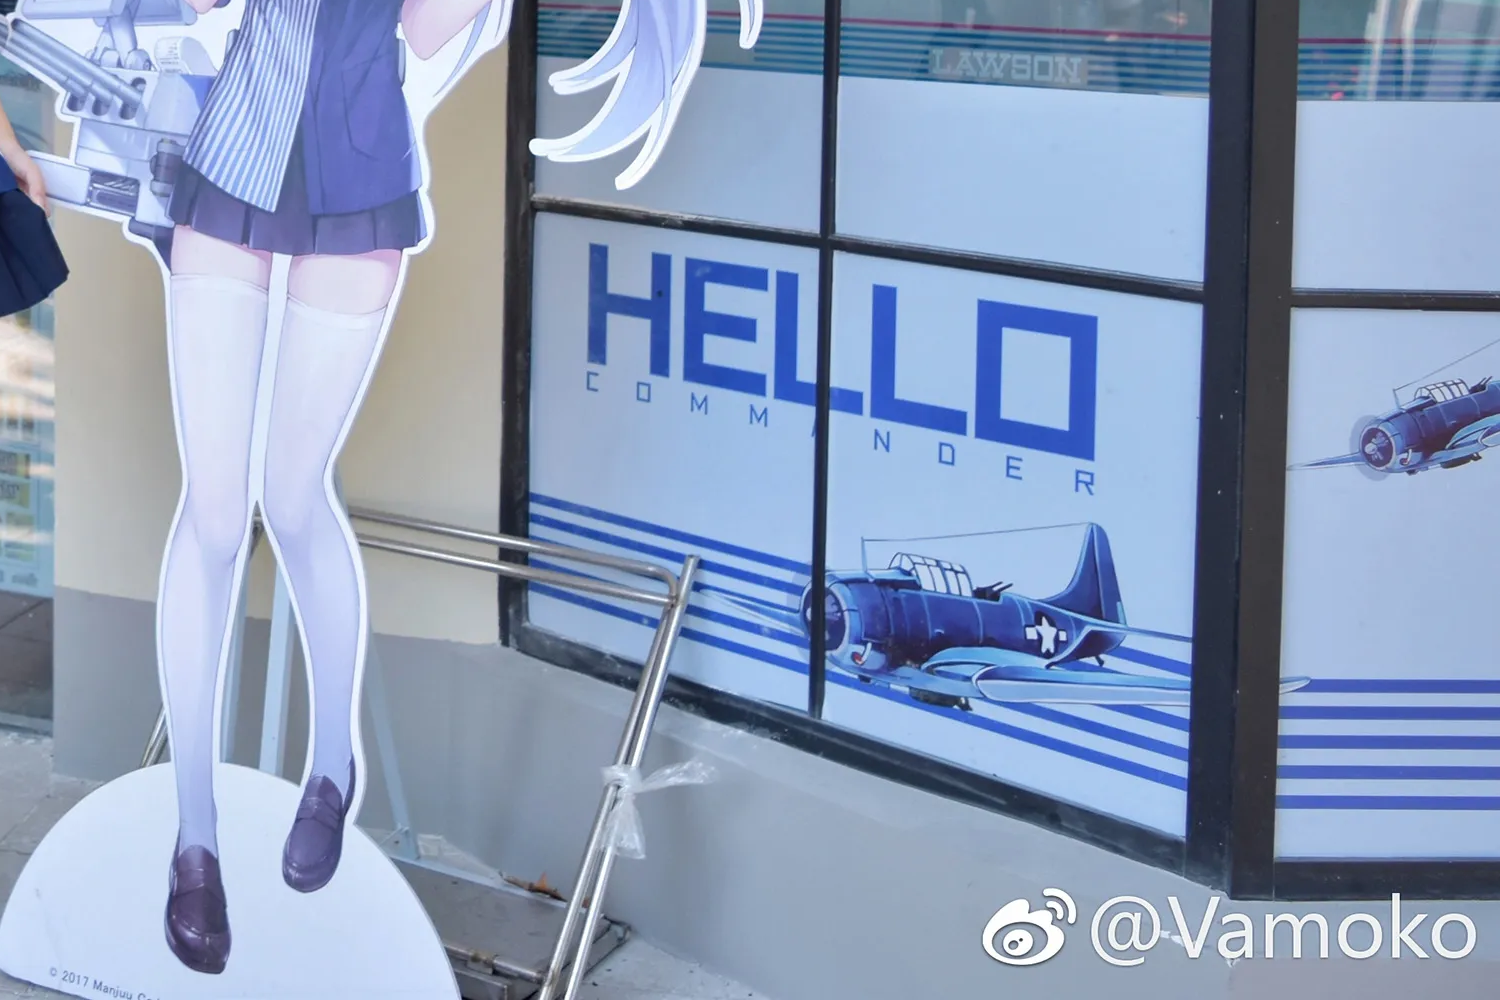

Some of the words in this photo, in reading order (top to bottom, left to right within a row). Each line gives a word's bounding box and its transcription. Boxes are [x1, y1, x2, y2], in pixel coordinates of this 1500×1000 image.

[932, 49, 1082, 84] LAWSON
[587, 243, 1098, 461] HELLO
[586, 371, 1095, 496] COMMNDER
[61, 969, 89, 987] 2017
